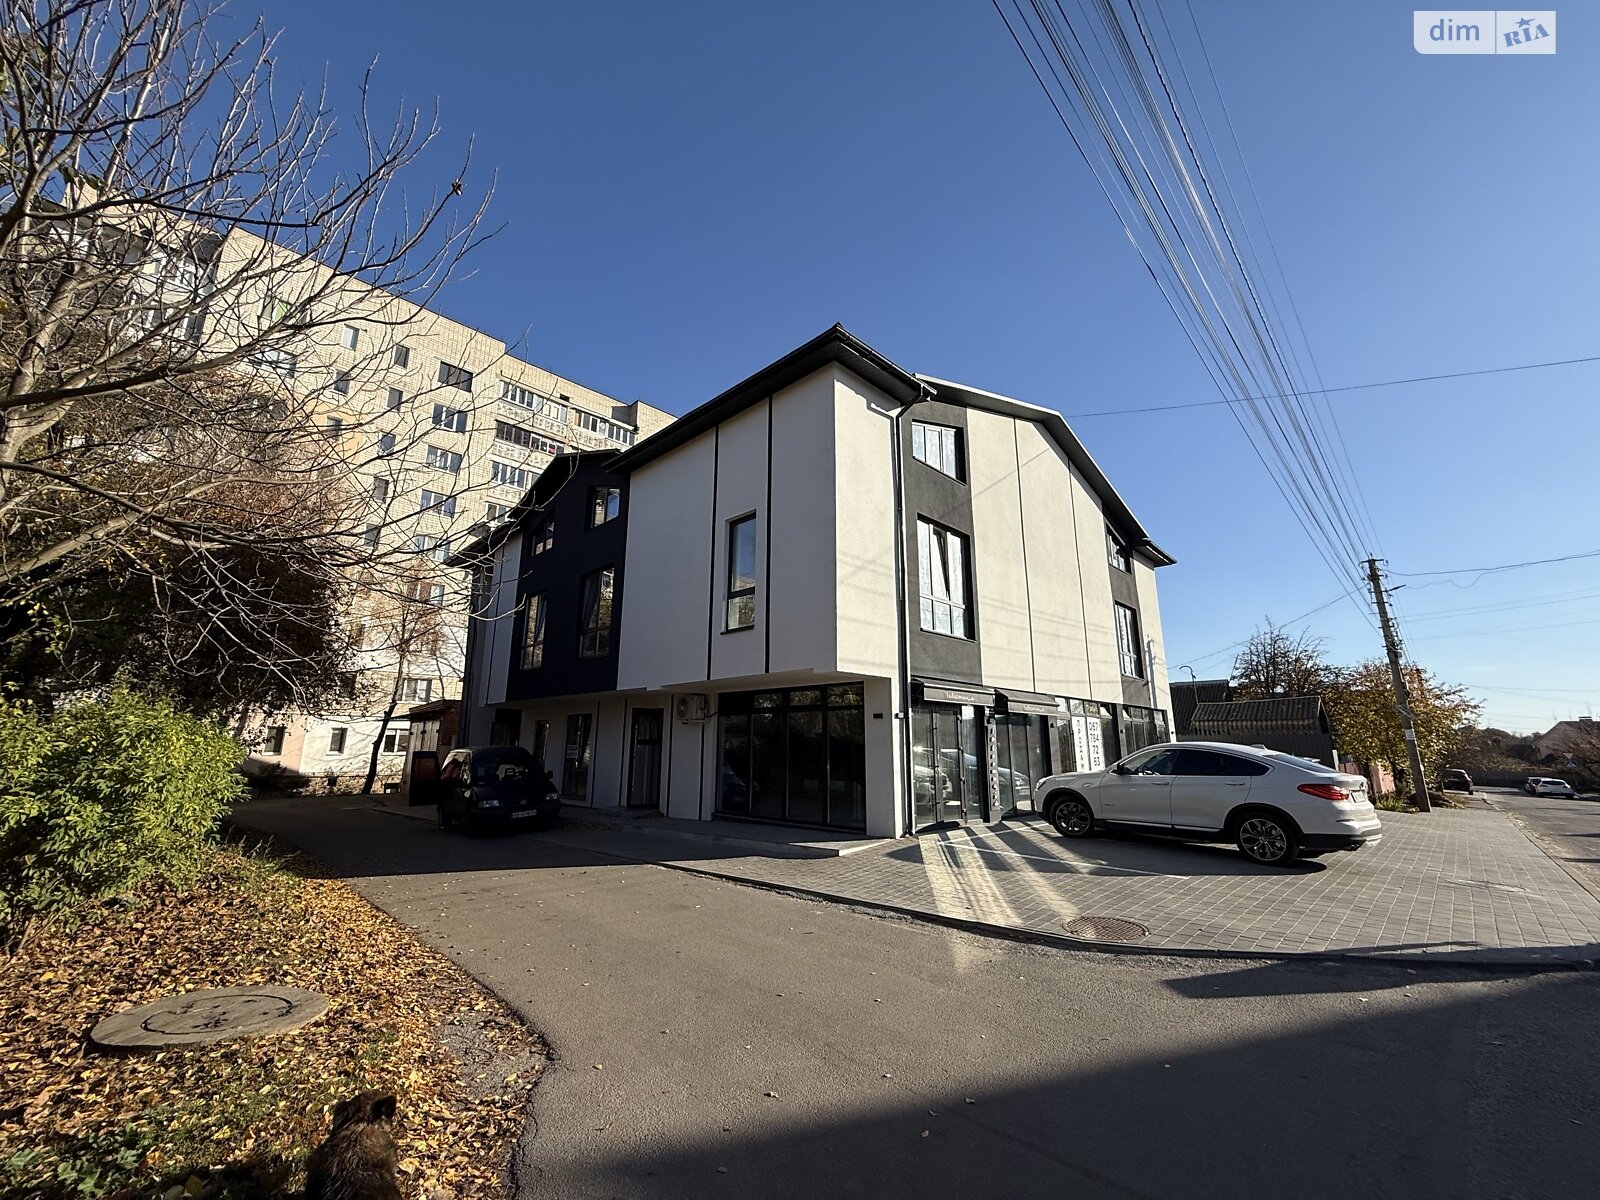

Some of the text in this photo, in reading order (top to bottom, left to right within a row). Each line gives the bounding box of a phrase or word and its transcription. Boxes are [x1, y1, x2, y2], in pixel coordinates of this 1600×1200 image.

[1089, 722, 1098, 731] 067
[1090, 733, 1099, 743] 784
[1077, 719, 1085, 769] ПРОДАМ
[1092, 745, 1099, 755] 72
[1094, 756, 1100, 766] 63
